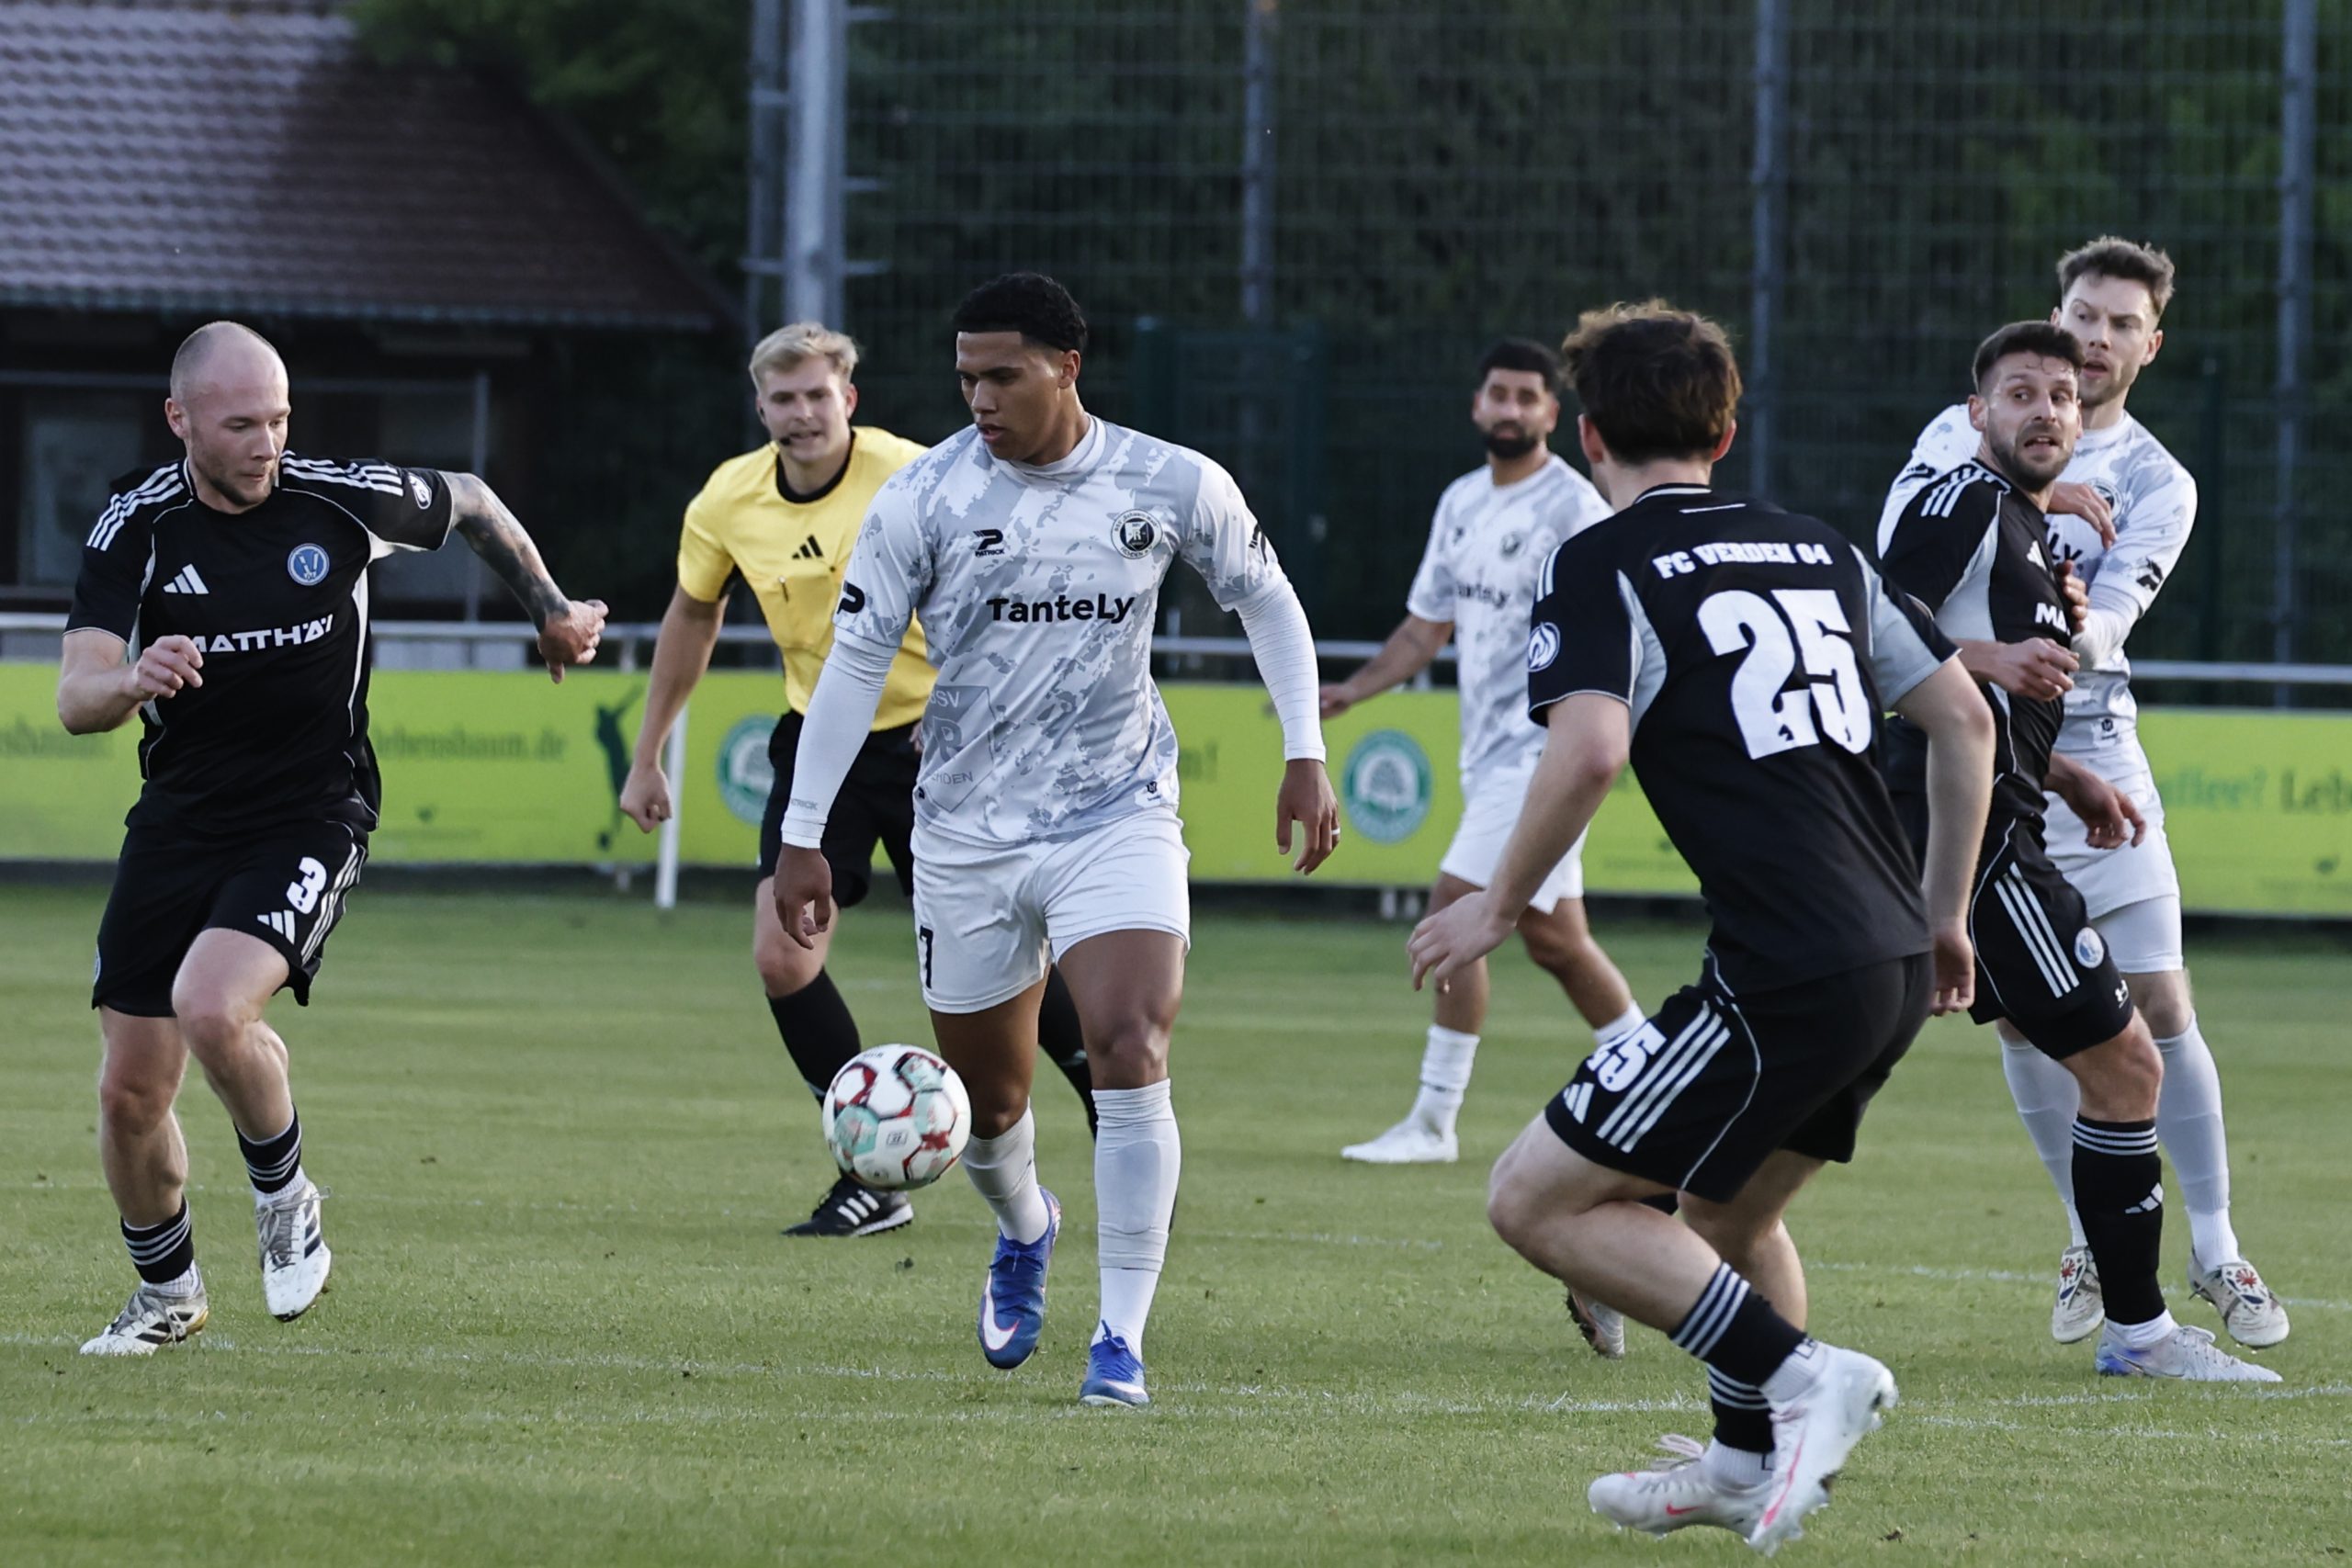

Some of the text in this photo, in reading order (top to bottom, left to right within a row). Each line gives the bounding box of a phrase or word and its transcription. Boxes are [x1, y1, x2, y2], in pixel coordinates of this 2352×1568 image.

[1653, 542, 1834, 579] FC VERDEN 04
[986, 593, 1136, 625] TanteLy
[1697, 589, 1872, 761] 25
[286, 856, 328, 915] 3
